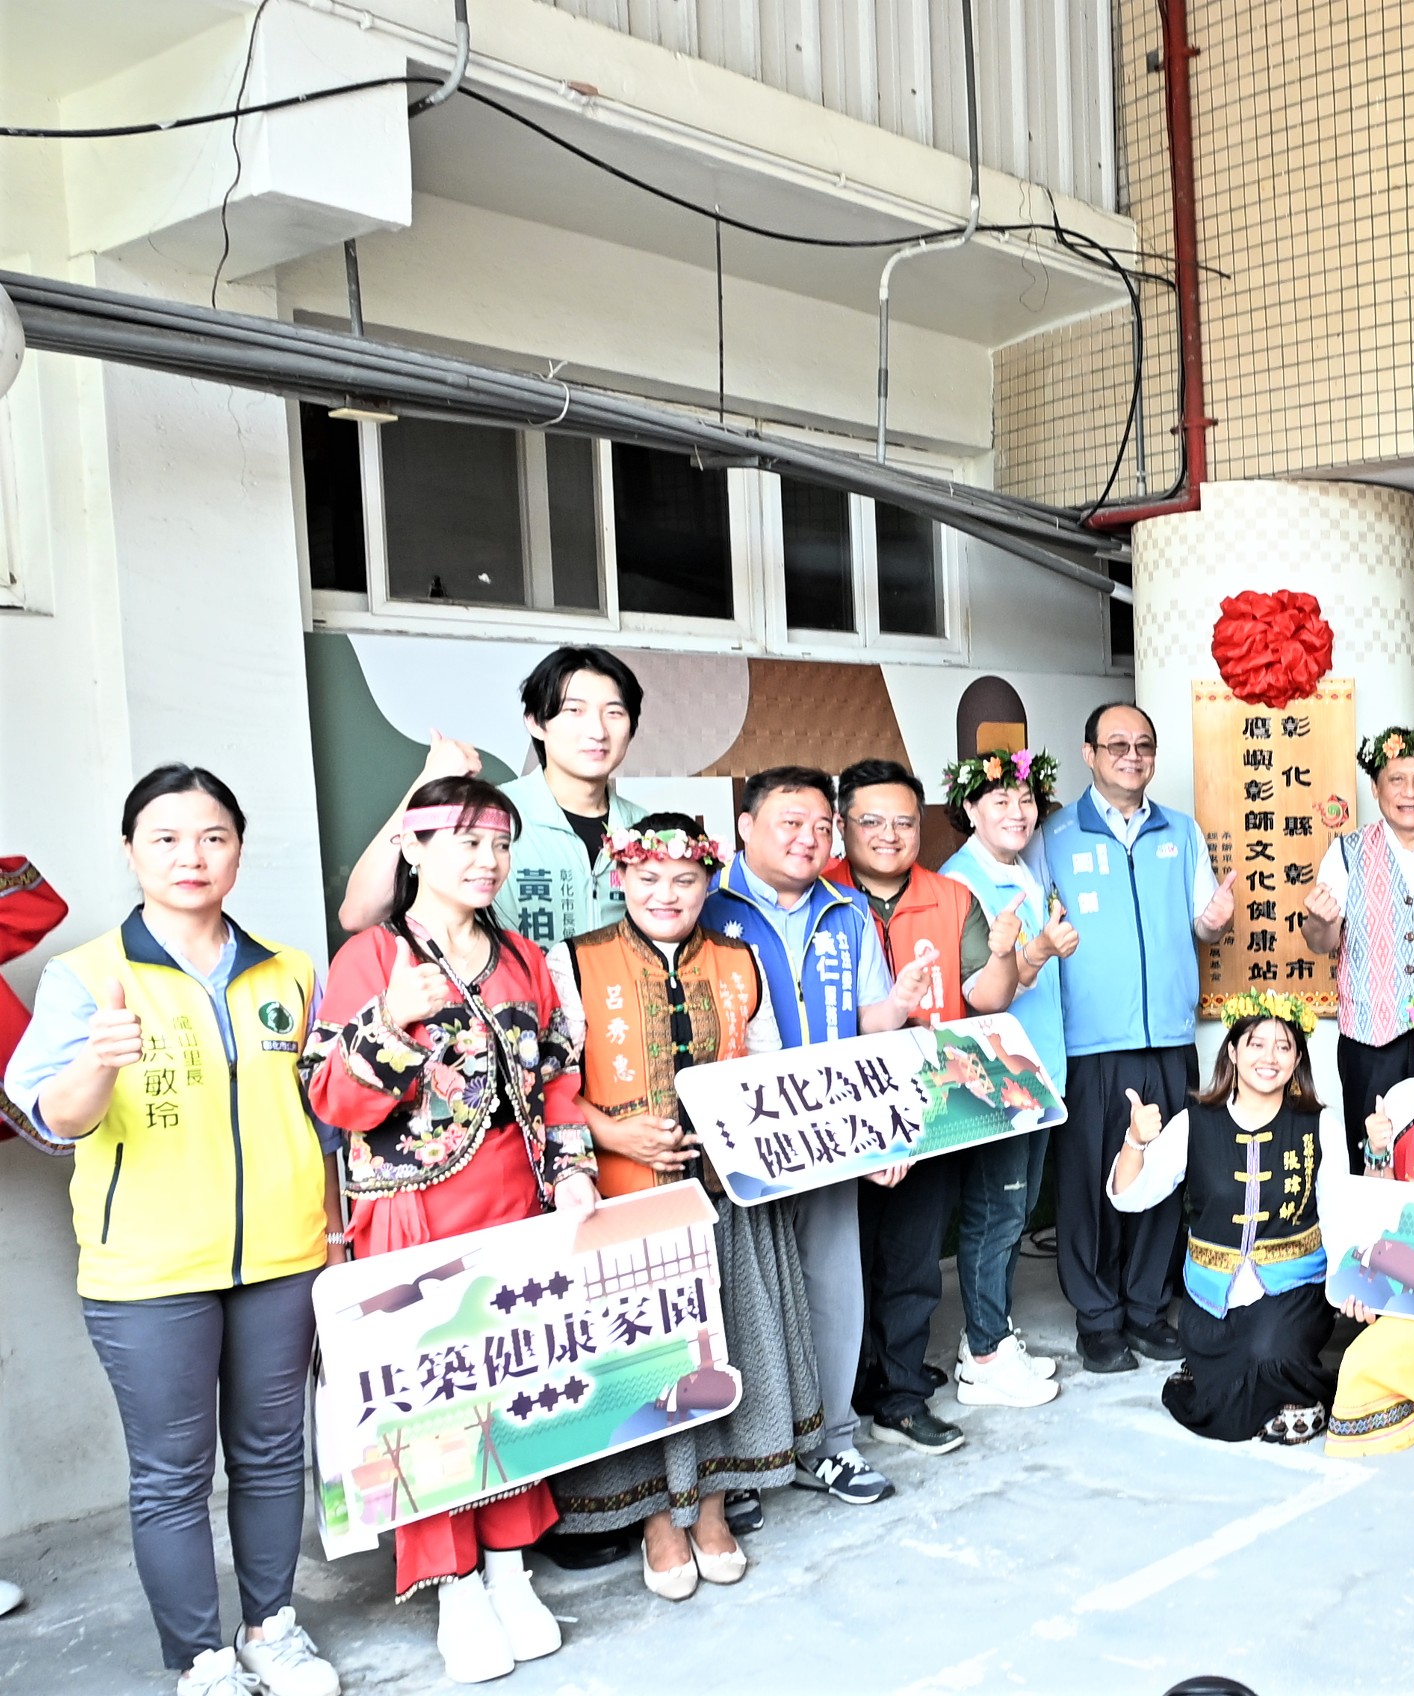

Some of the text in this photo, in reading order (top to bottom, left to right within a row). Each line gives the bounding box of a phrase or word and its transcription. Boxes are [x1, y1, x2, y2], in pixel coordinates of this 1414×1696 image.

[1242, 716, 1278, 981] 鷹嶼彰師文化健康站
[516, 868, 555, 950] 黃柏
[740, 1056, 899, 1127] 文化為根
[754, 1104, 921, 1179] 健康為本
[356, 1277, 708, 1428] 共築健康家園
